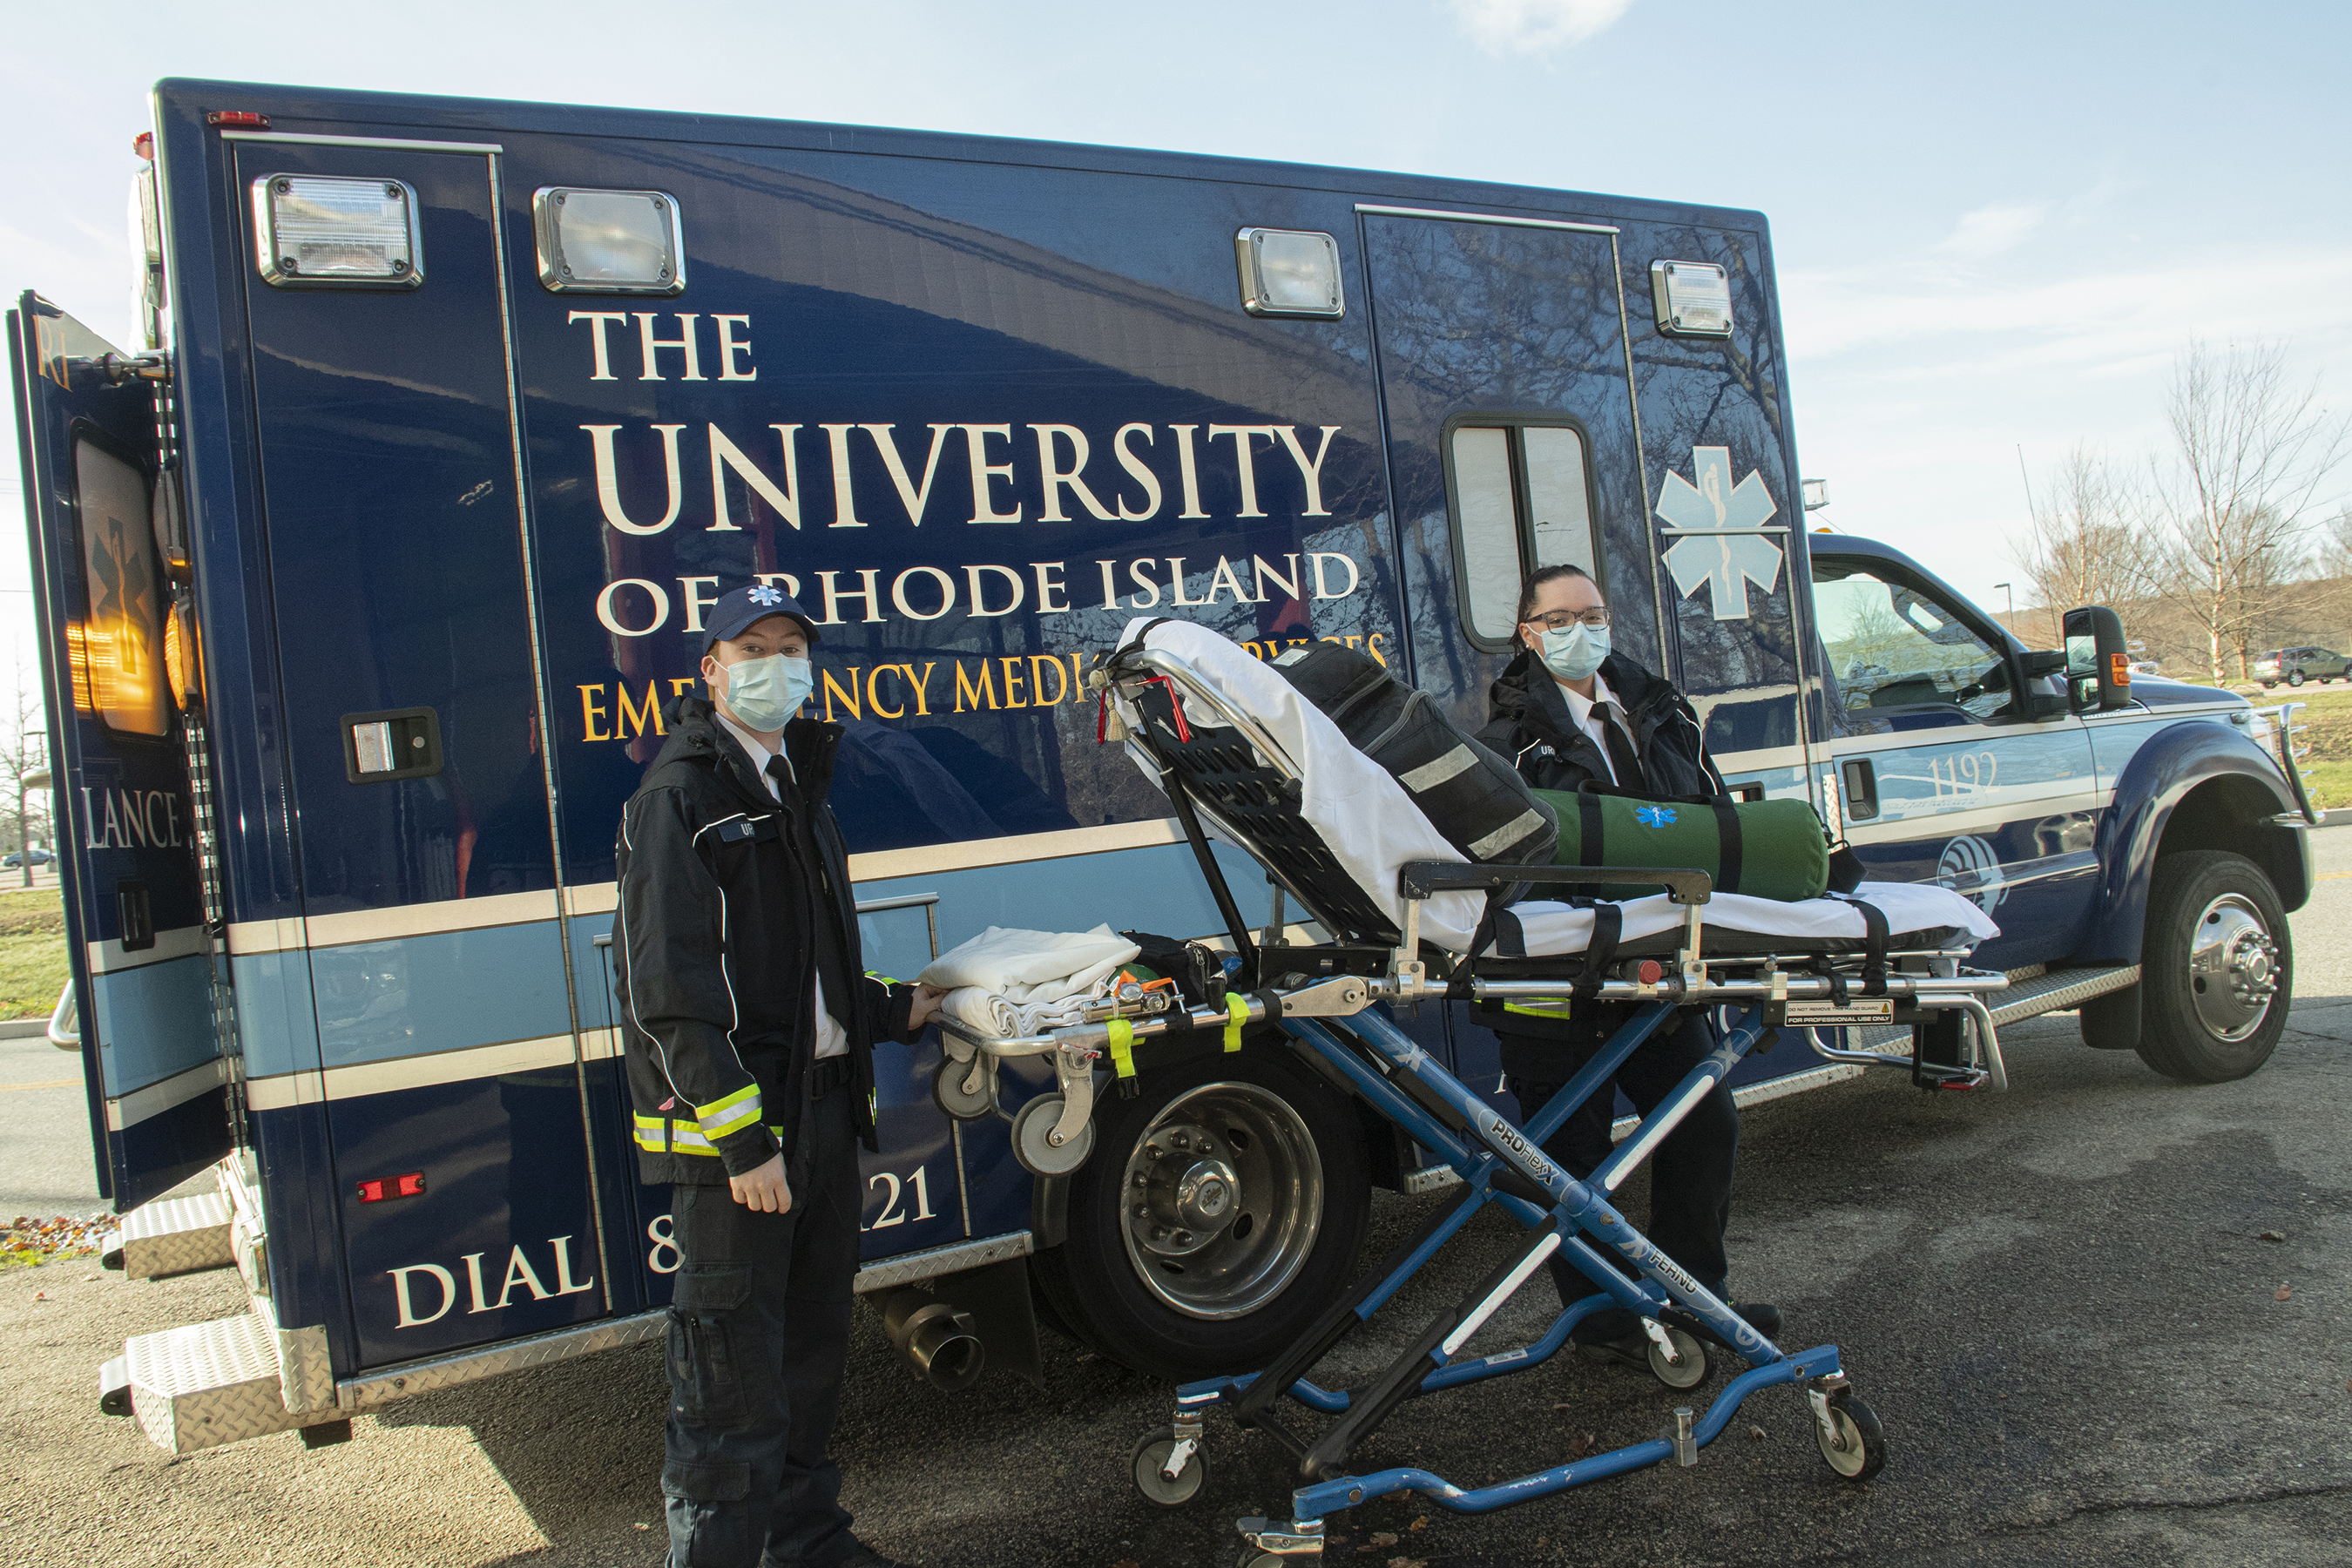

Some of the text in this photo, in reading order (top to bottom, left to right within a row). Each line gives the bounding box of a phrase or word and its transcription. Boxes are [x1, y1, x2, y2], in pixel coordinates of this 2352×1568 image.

[568, 310, 757, 381] THE
[578, 422, 1342, 536] UNIVERSITY
[597, 575, 720, 637] OF
[1095, 552, 1359, 611] ISLAND
[1927, 751, 2002, 801] 1192
[80, 787, 182, 848] LANCE
[387, 1235, 593, 1329] DIAL
[1649, 1249, 1698, 1295] FERNO
